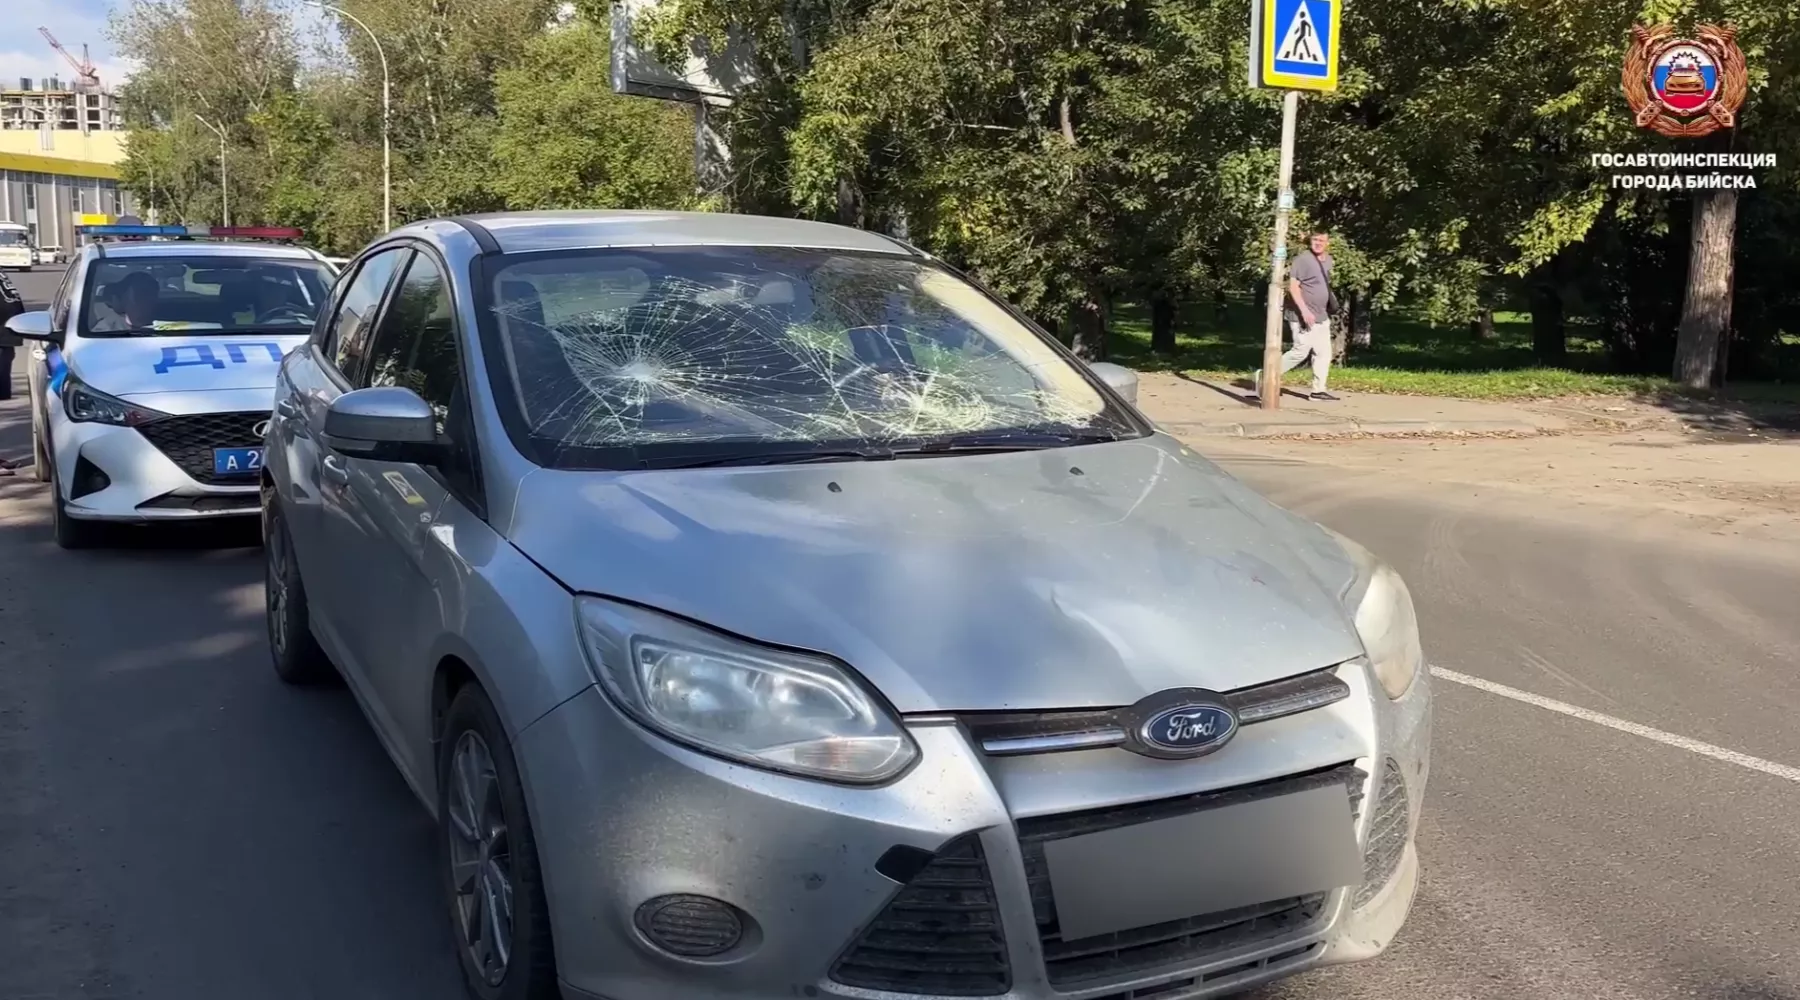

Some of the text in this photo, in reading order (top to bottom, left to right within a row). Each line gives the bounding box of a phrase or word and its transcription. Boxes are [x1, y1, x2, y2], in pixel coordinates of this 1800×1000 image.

[153, 343, 284, 374] ДП
[247, 450, 263, 469] 2
[1167, 712, 1216, 742] Ford
